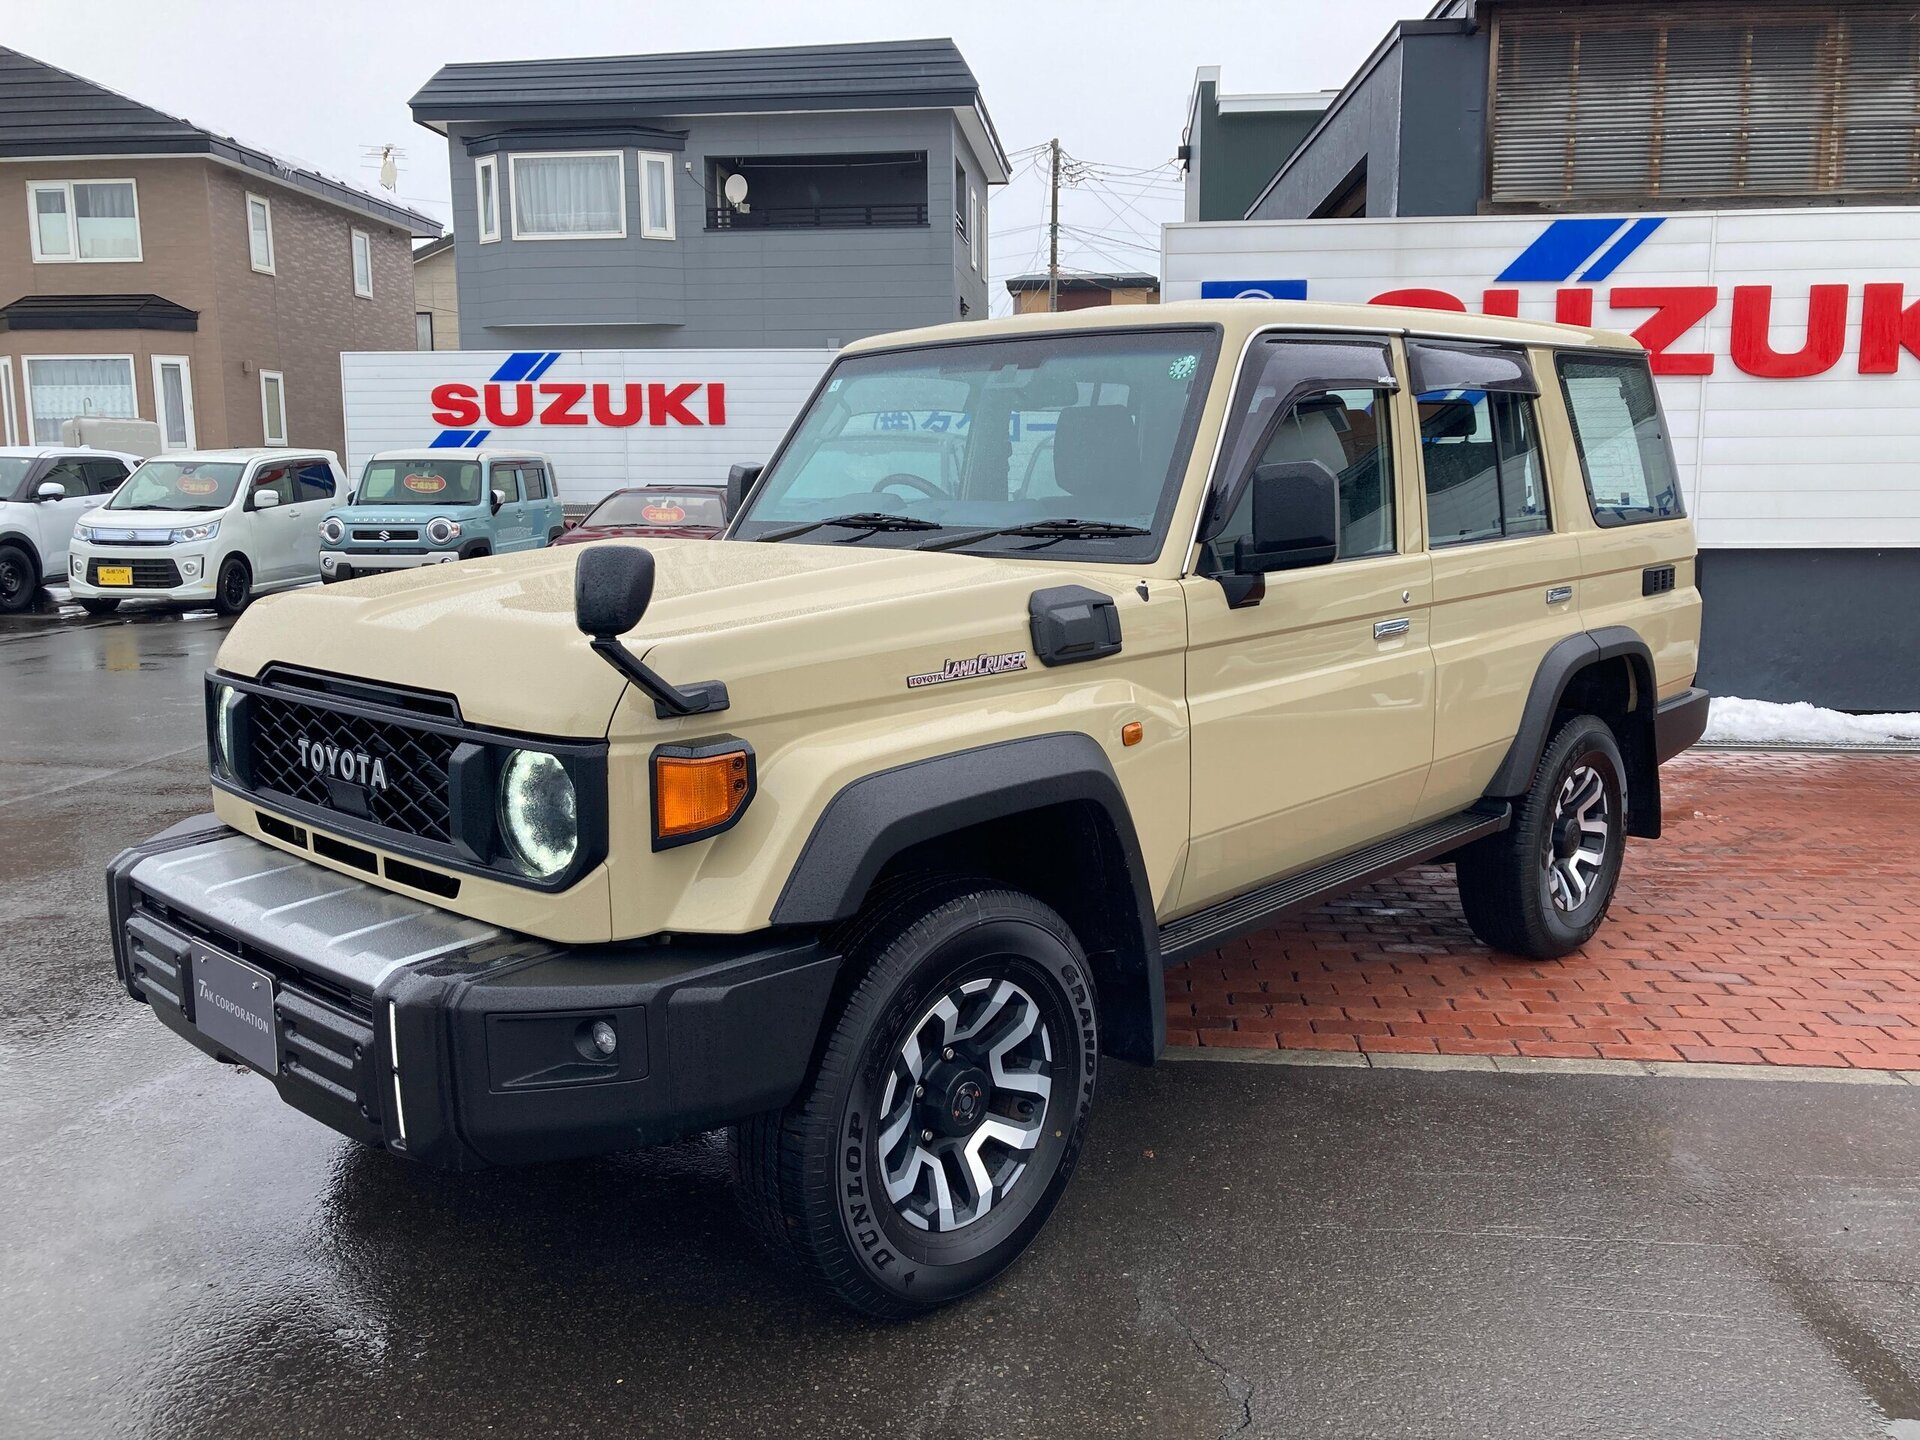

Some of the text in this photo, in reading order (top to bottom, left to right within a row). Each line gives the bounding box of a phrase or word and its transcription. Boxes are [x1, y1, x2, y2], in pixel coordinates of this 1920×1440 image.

[431, 383, 726, 427] SUZUKI
[911, 673, 943, 686] TOYOTA
[298, 738, 388, 790] TOYOTA
[215, 994, 269, 1034] CORPORATION
[845, 1111, 896, 1271] DUNLOP
